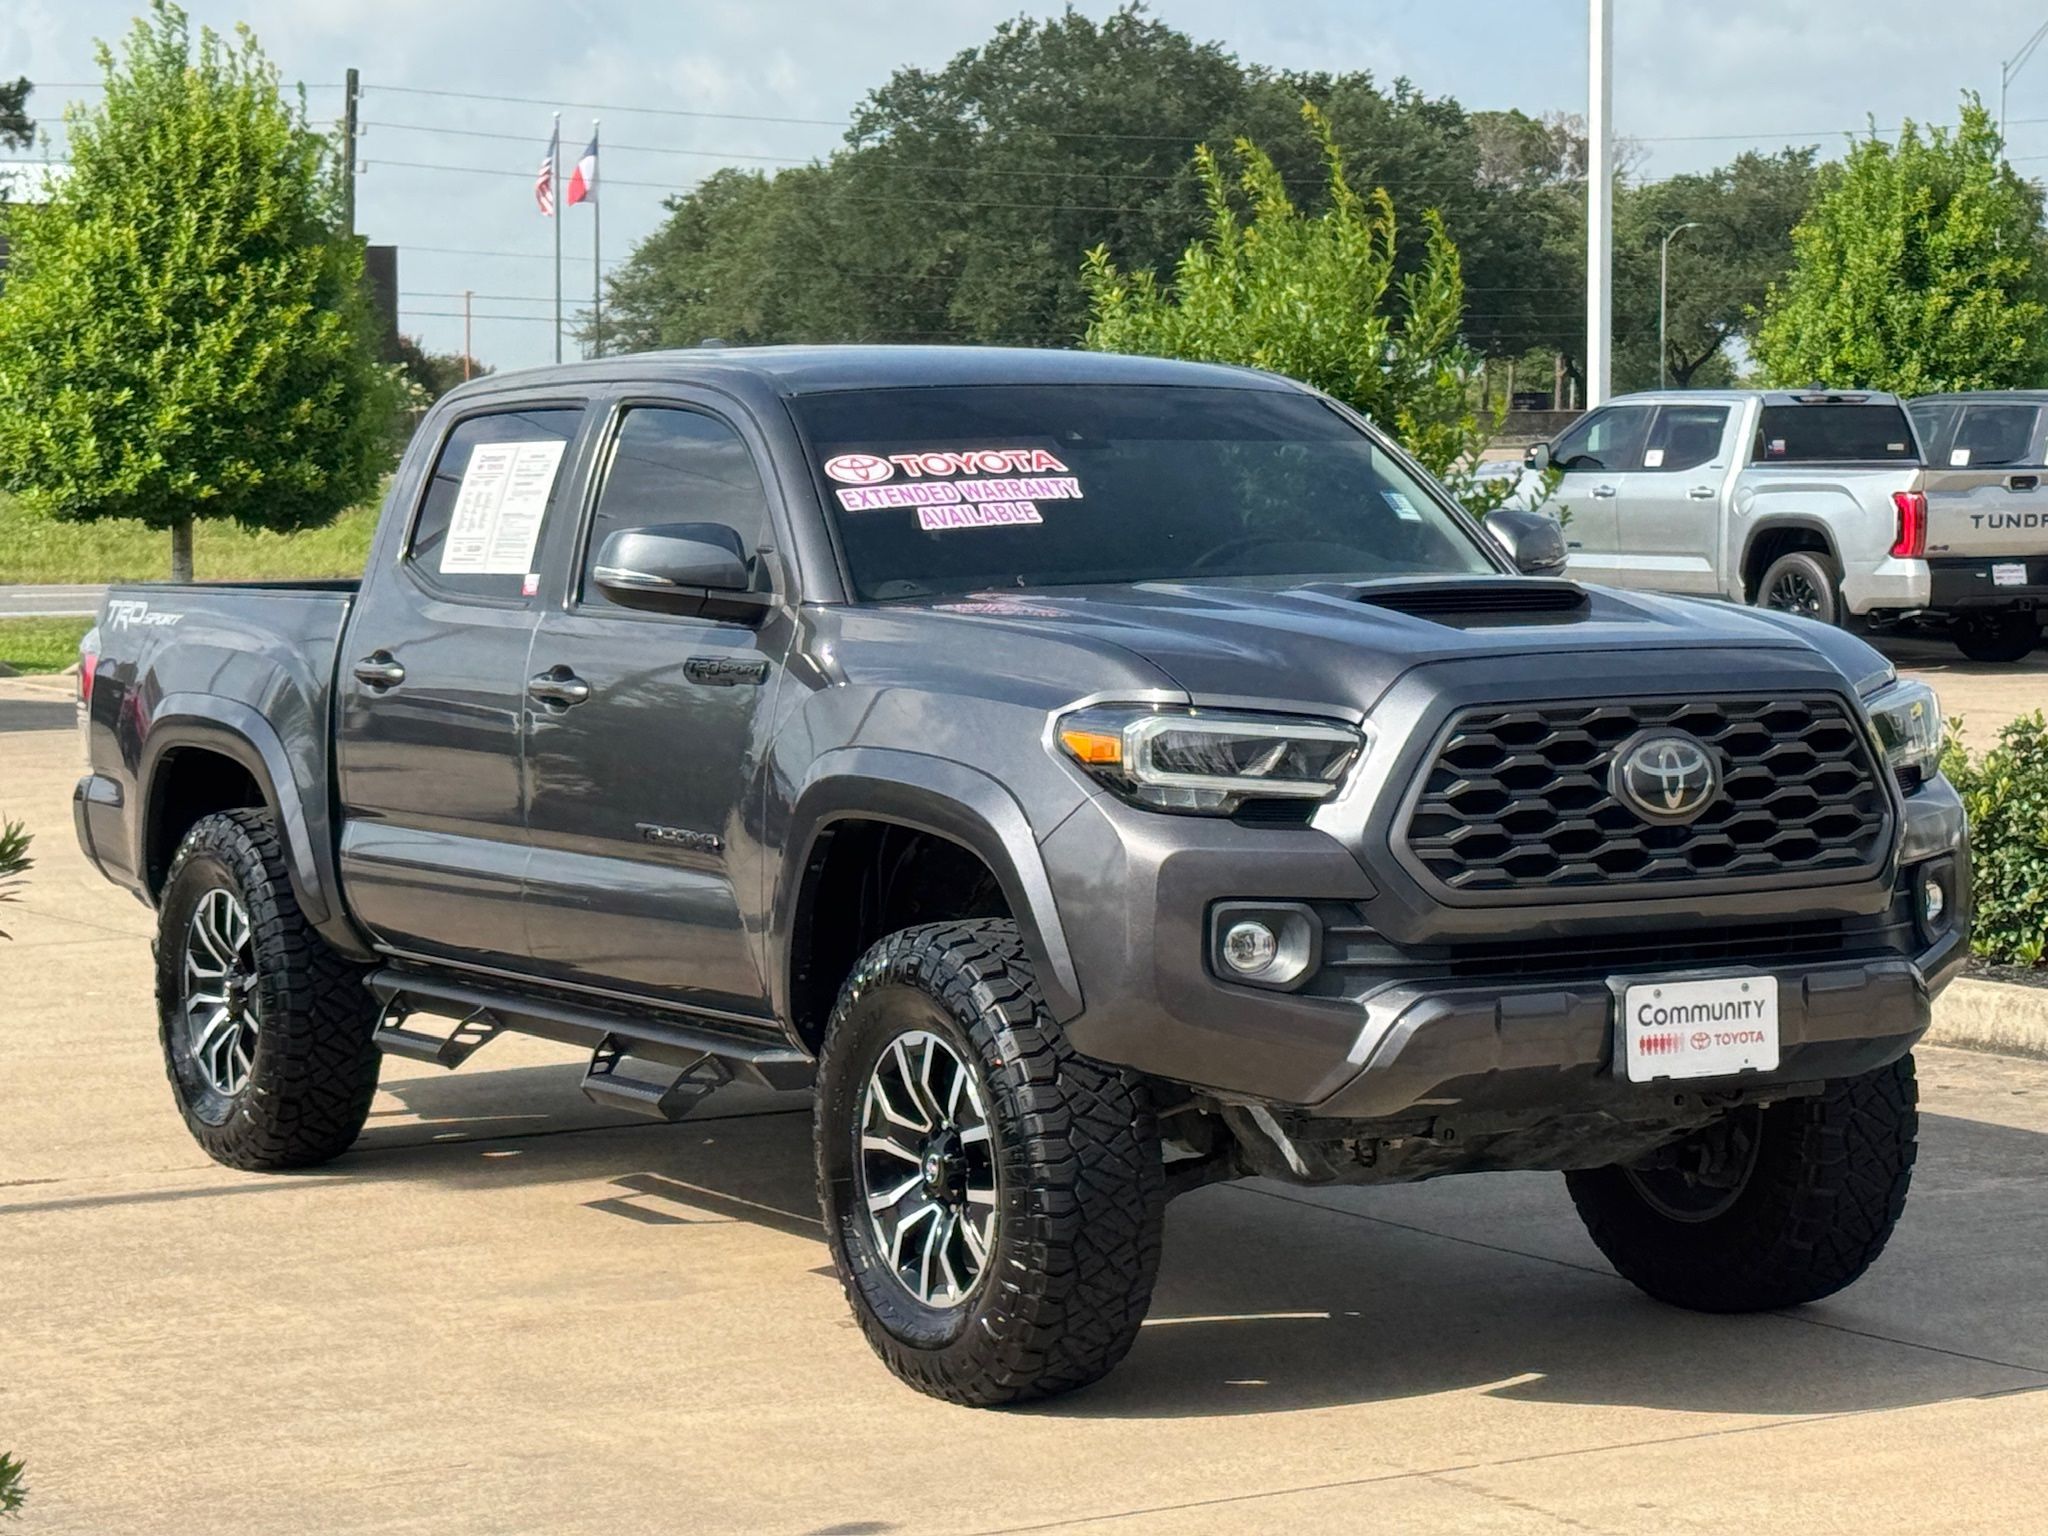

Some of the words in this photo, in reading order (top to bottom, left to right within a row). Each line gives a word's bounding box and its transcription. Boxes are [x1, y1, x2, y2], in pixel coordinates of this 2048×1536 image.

[889, 450, 1068, 477] TOYOTA
[840, 481, 959, 509] EXTENDED
[960, 479, 1079, 501] WARRANTY
[922, 504, 1038, 528] AVAILABLE
[108, 600, 148, 632] TRD
[687, 660, 720, 679] TRD
[1715, 1031, 1764, 1046] TOYOTA
